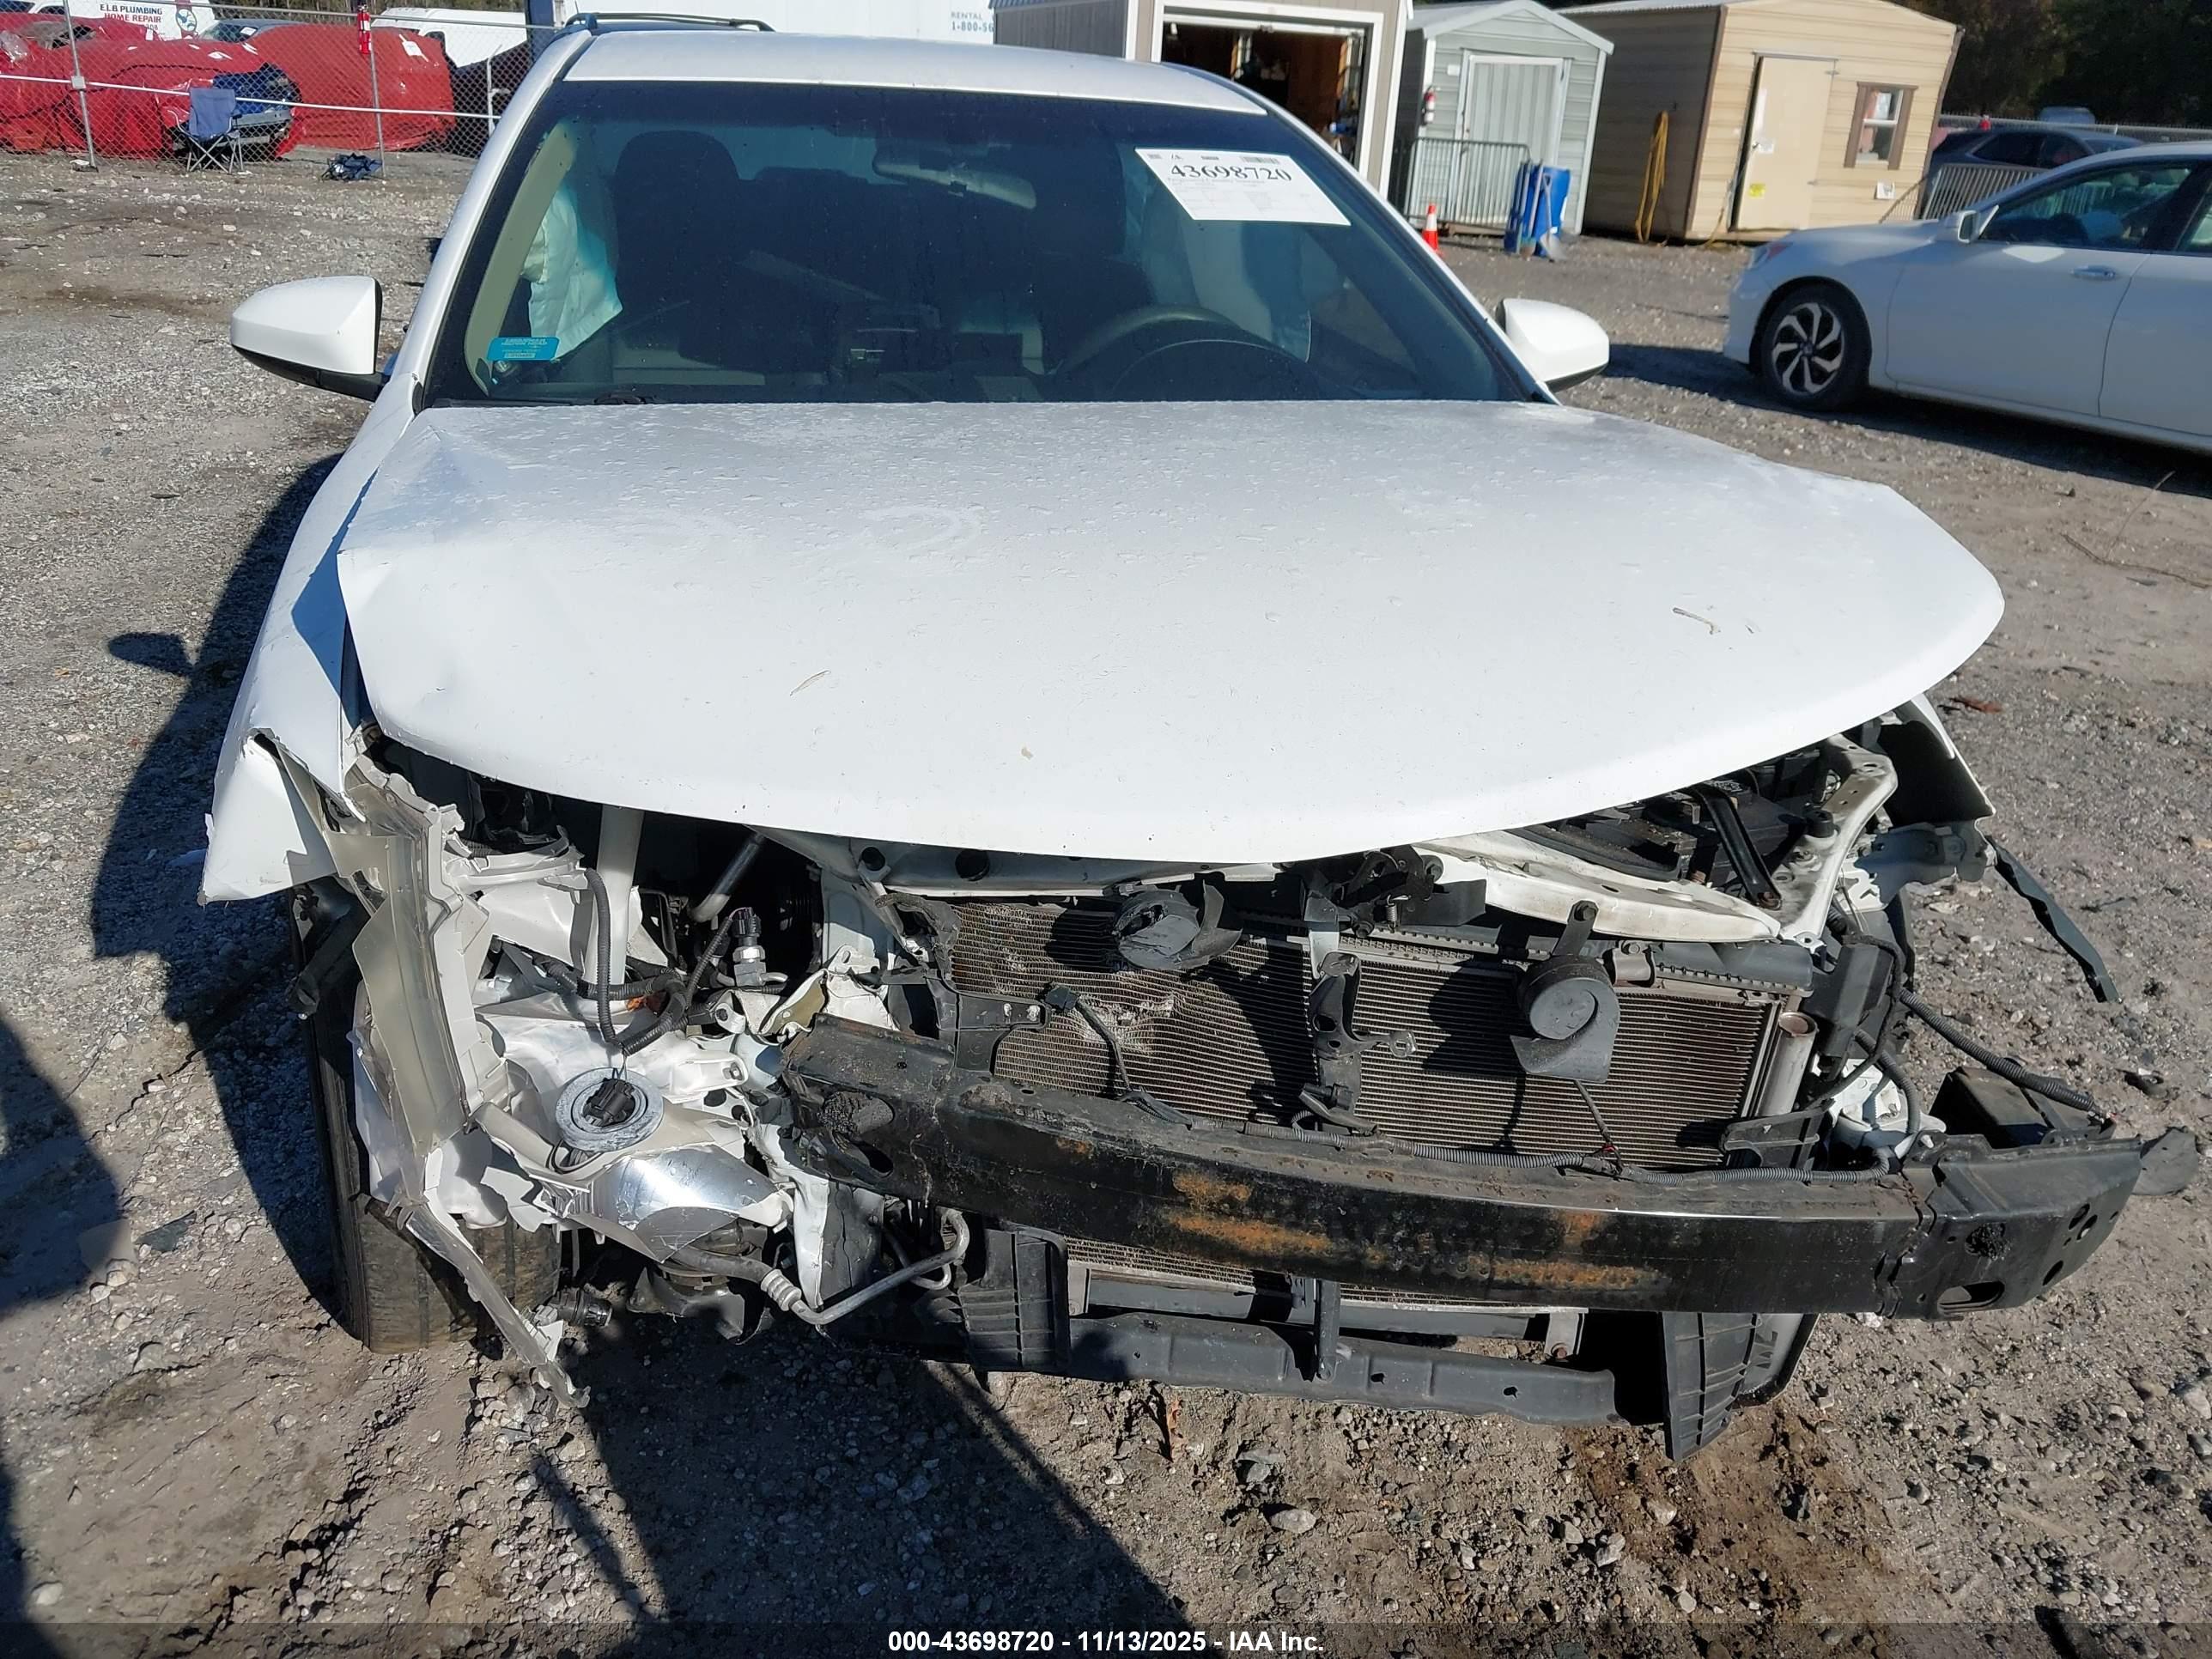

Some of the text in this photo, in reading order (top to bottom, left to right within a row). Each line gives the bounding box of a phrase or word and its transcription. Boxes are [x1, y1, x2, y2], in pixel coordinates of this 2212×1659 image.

[119, 5, 162, 15] PLUMBING
[104, 12, 161, 23] HOME REPAIR
[951, 11, 982, 20] RENTAL
[1171, 164, 1292, 181] 43698720
